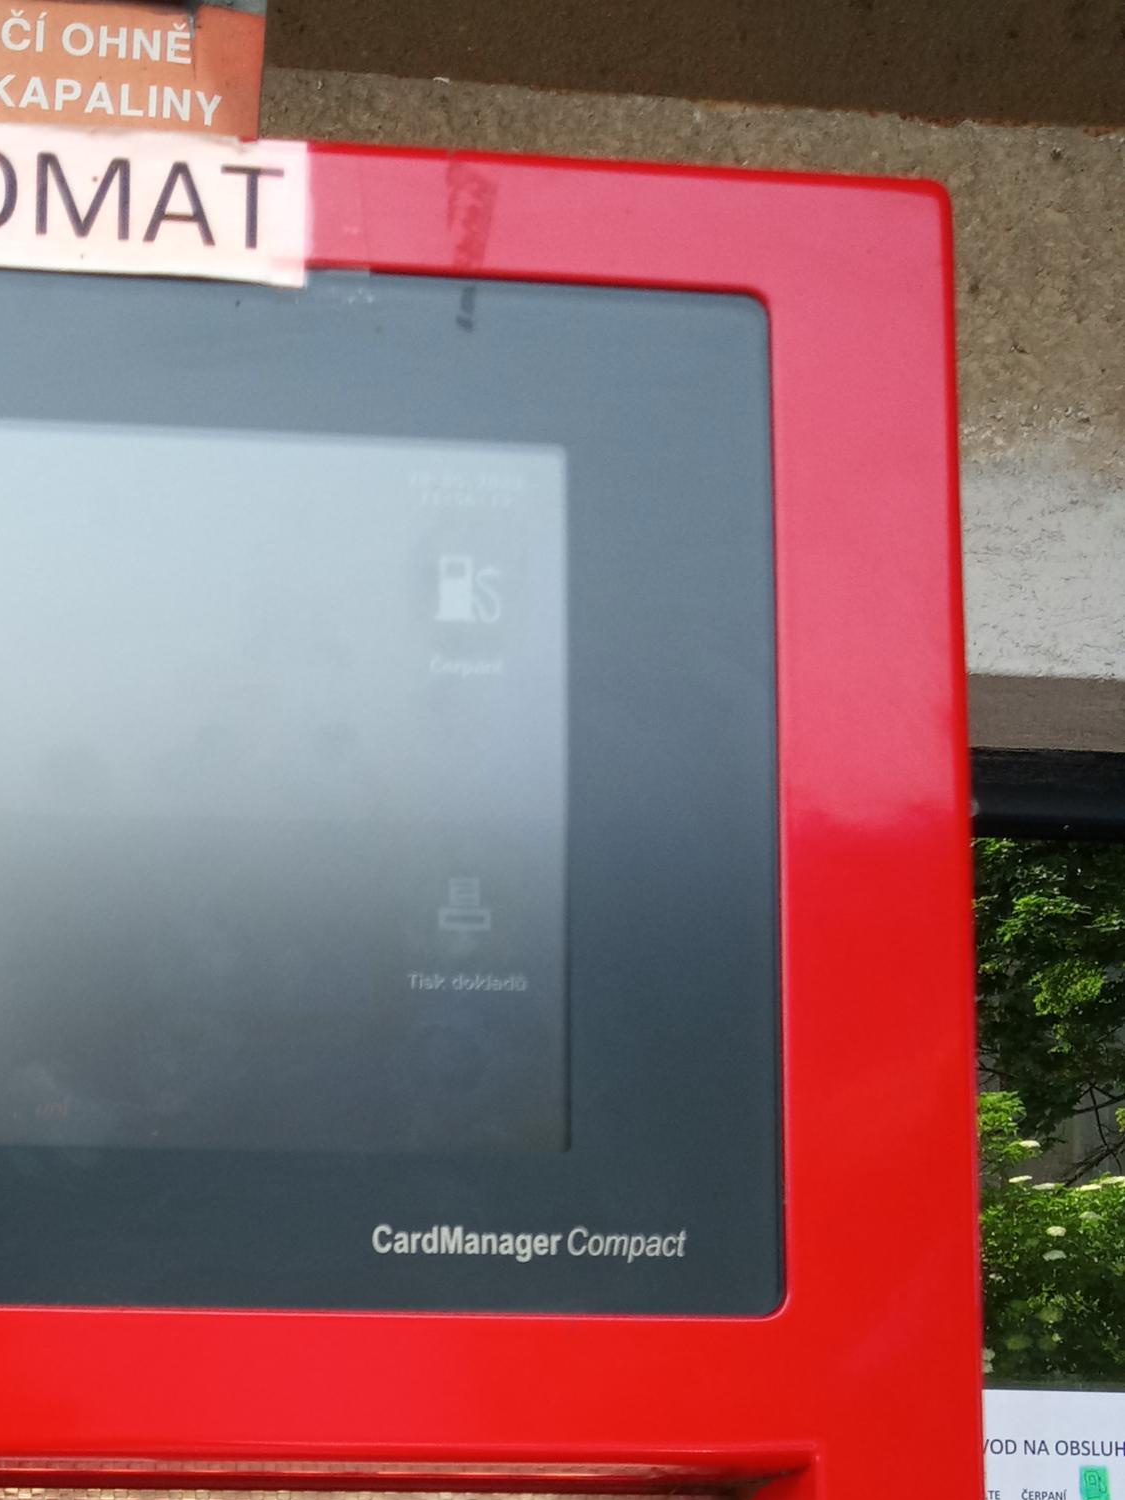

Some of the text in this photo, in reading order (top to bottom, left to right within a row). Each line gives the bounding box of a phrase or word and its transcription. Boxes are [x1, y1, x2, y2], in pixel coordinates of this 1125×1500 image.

[61, 22, 192, 65] OHNĚ
[372, 1224, 687, 1263] CardManager Compact
[1024, 1440, 1050, 1455] NA
[985, 1490, 1000, 1500] TE
